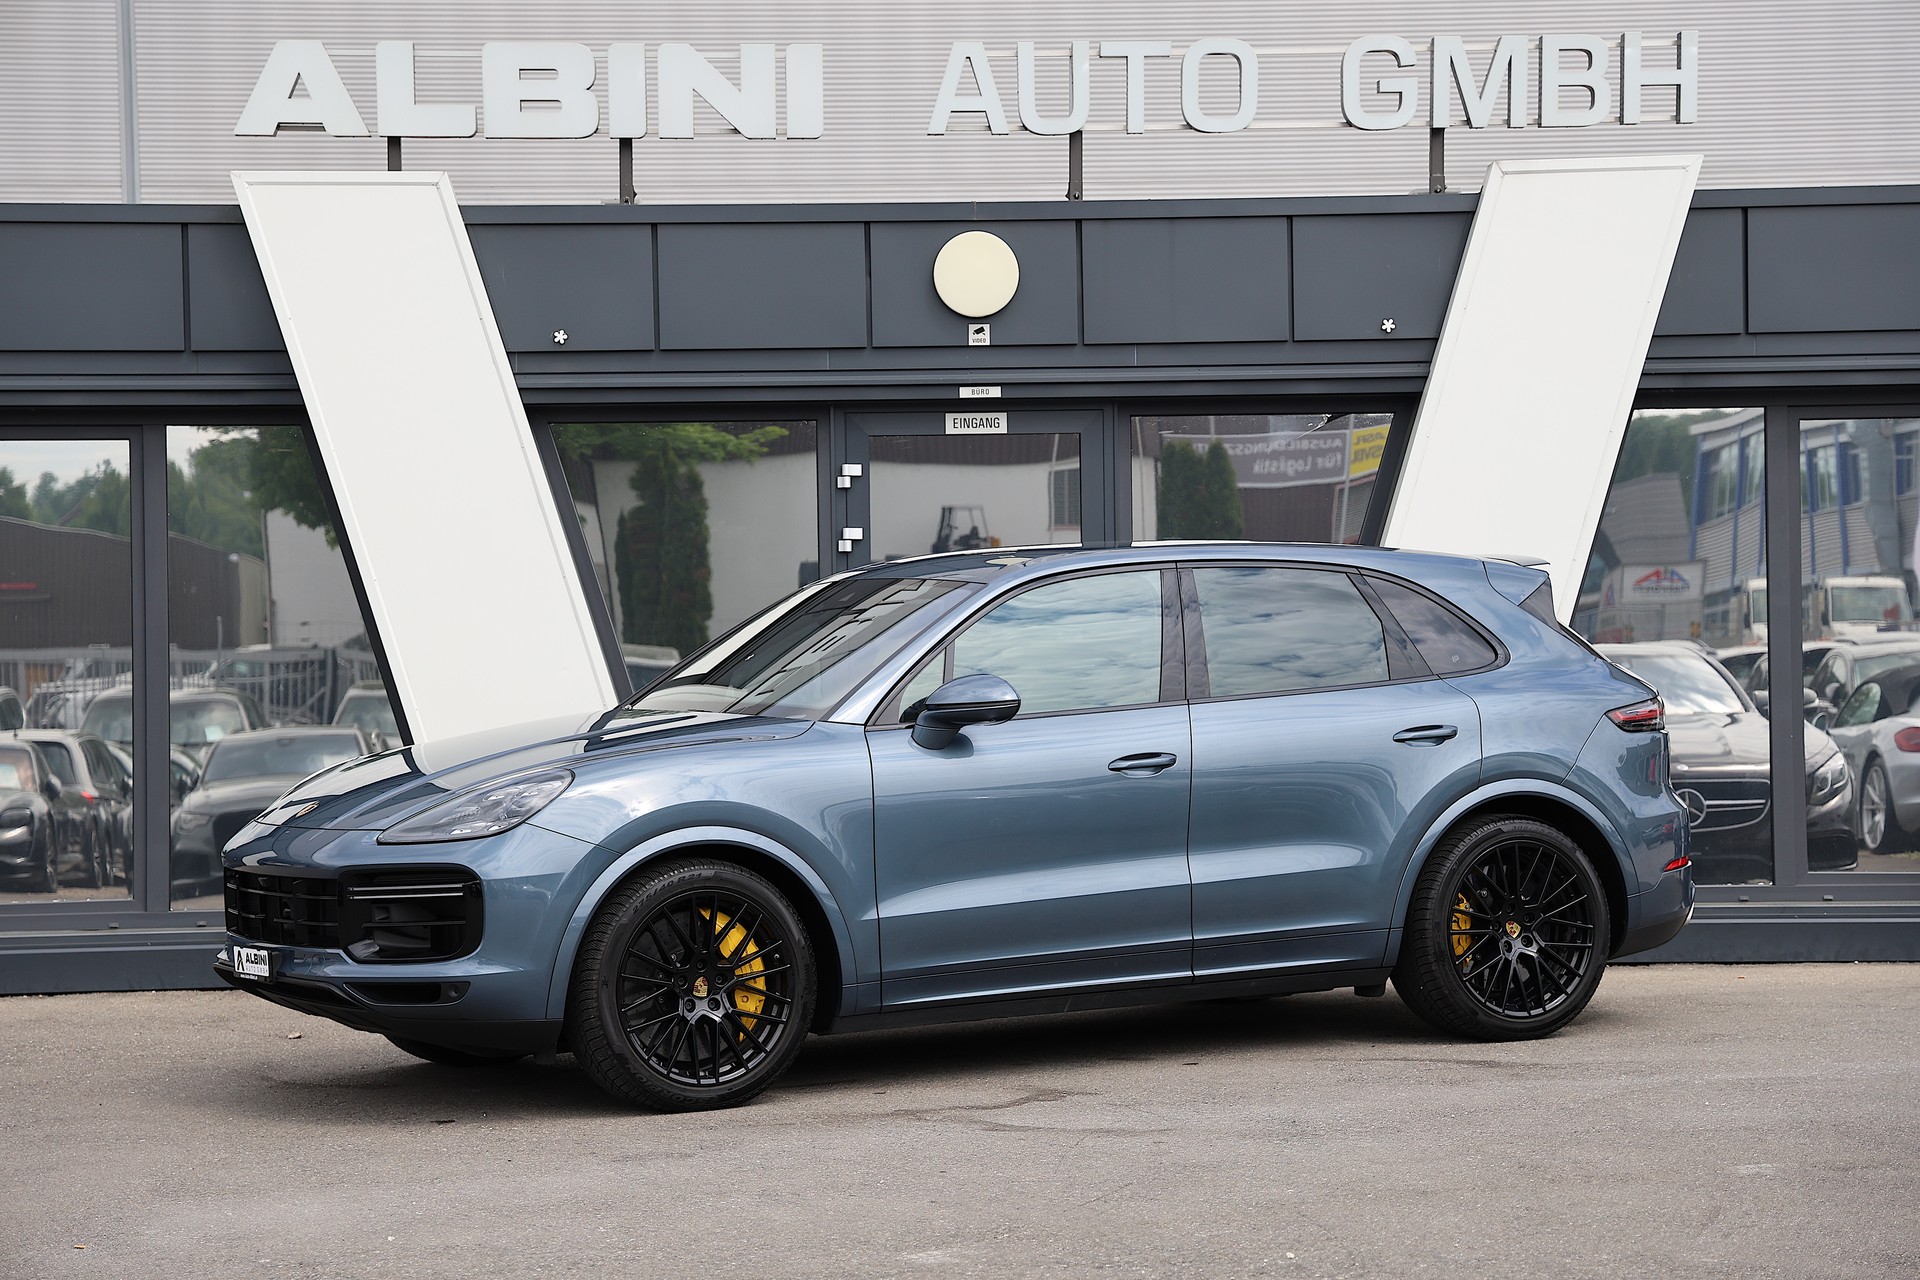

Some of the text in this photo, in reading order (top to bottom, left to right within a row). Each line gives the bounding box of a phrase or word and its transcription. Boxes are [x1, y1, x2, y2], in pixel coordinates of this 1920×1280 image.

[234, 30, 1699, 139] ALBINI AUTO GMBH
[971, 387, 990, 396] BÜRO
[953, 417, 1000, 429] EINGANG
[246, 952, 267, 966] ALBINI
